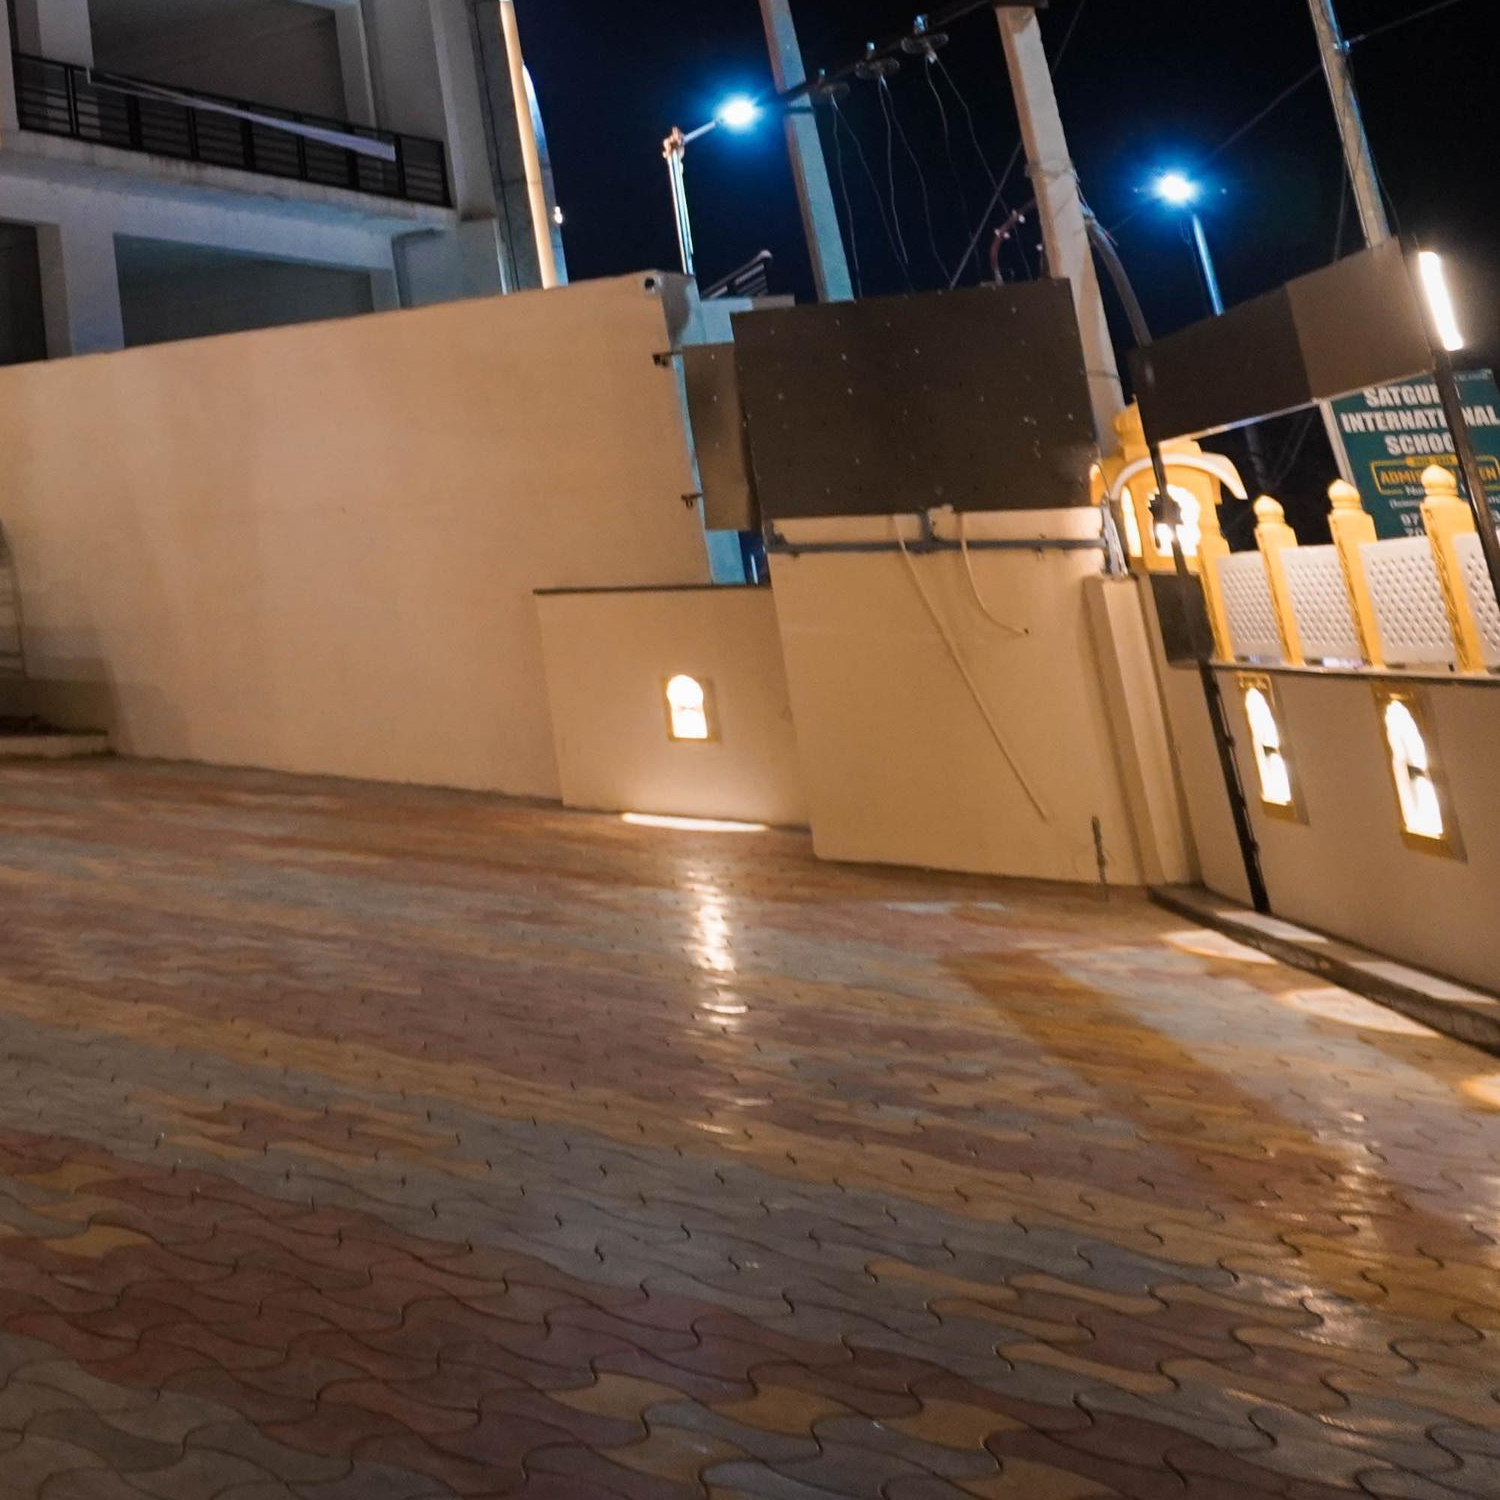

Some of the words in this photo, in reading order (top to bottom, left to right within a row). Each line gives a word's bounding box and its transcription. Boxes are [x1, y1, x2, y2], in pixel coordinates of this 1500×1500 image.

[1363, 383, 1459, 408] SATGU
[1340, 405, 1500, 433] INTERNATINAL
[1384, 432, 1456, 456] SCHOO
